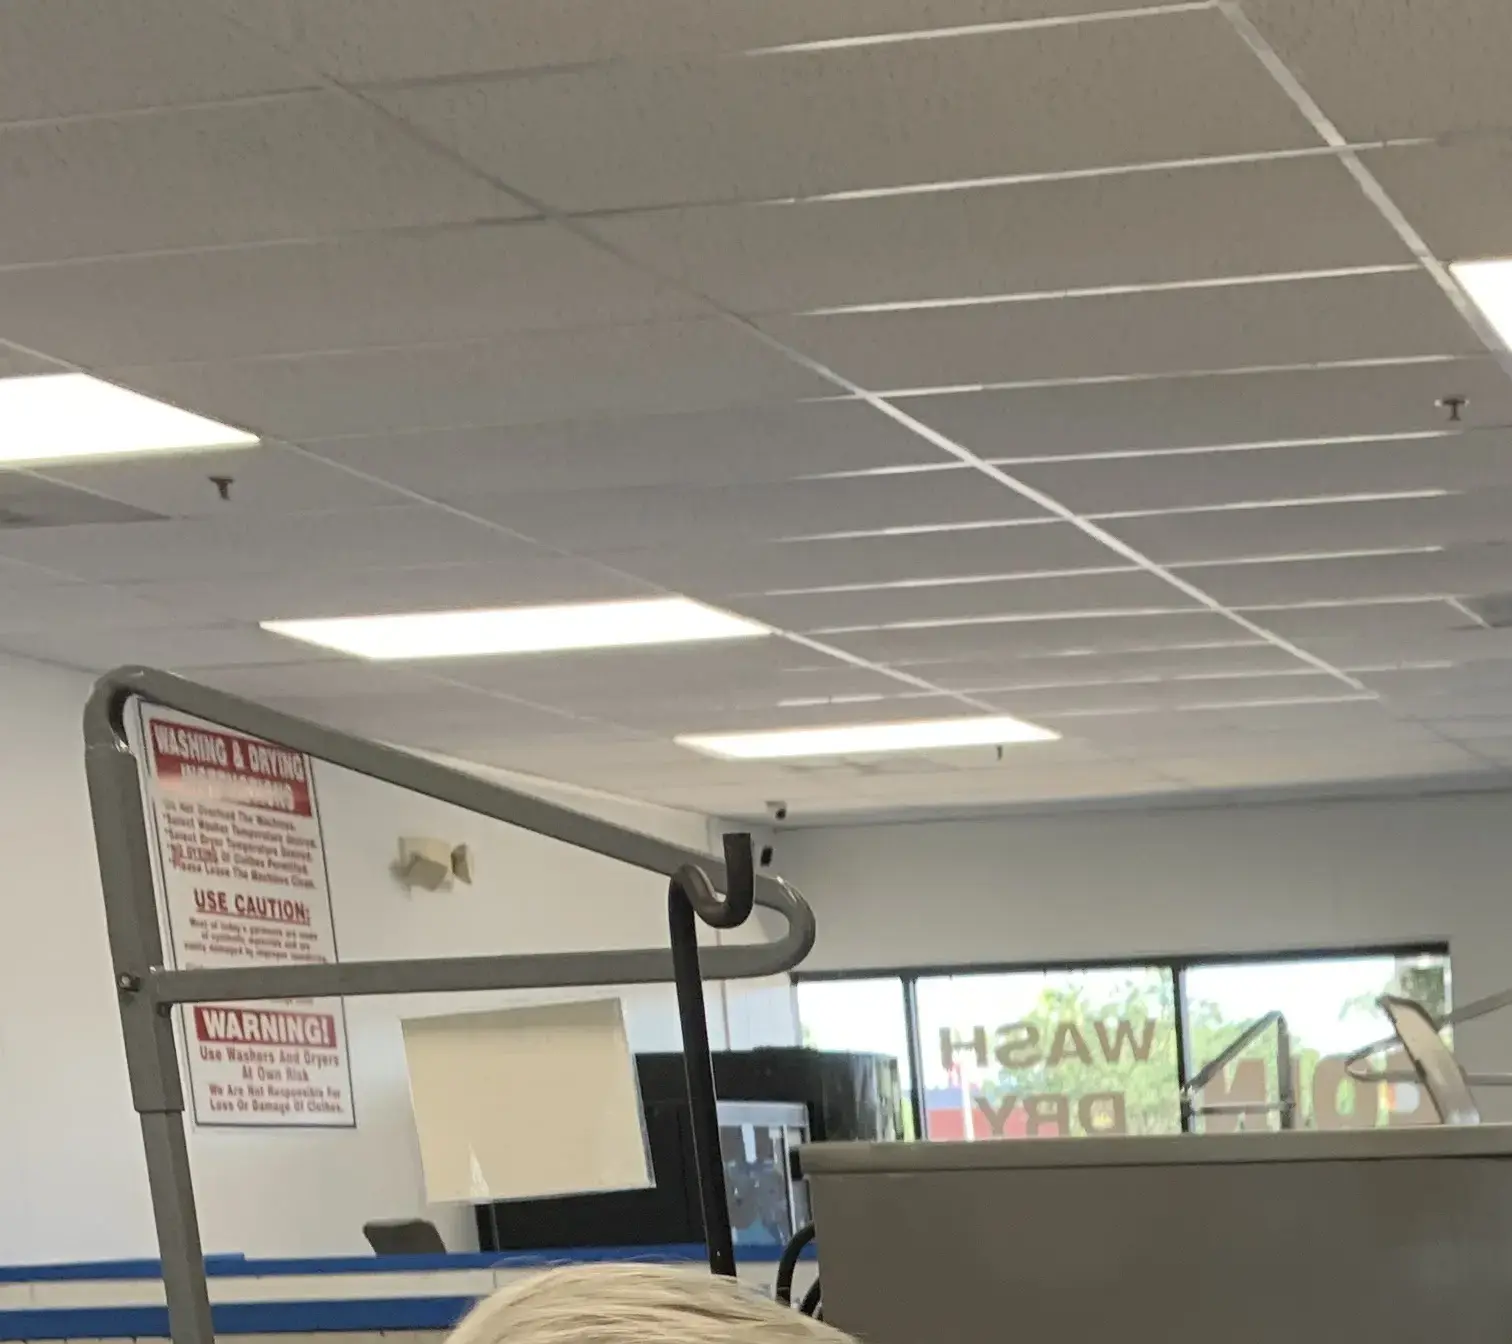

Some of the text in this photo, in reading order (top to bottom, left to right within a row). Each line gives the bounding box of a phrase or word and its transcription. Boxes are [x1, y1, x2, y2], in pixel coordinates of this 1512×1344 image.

[153, 723, 228, 766] WASHING
[248, 743, 305, 782] DRYING
[194, 888, 228, 911] USE
[202, 1008, 330, 1044] WARNING!
[200, 1046, 340, 1069] Use Washers And Dryers
[258, 1066, 282, 1081] Own
